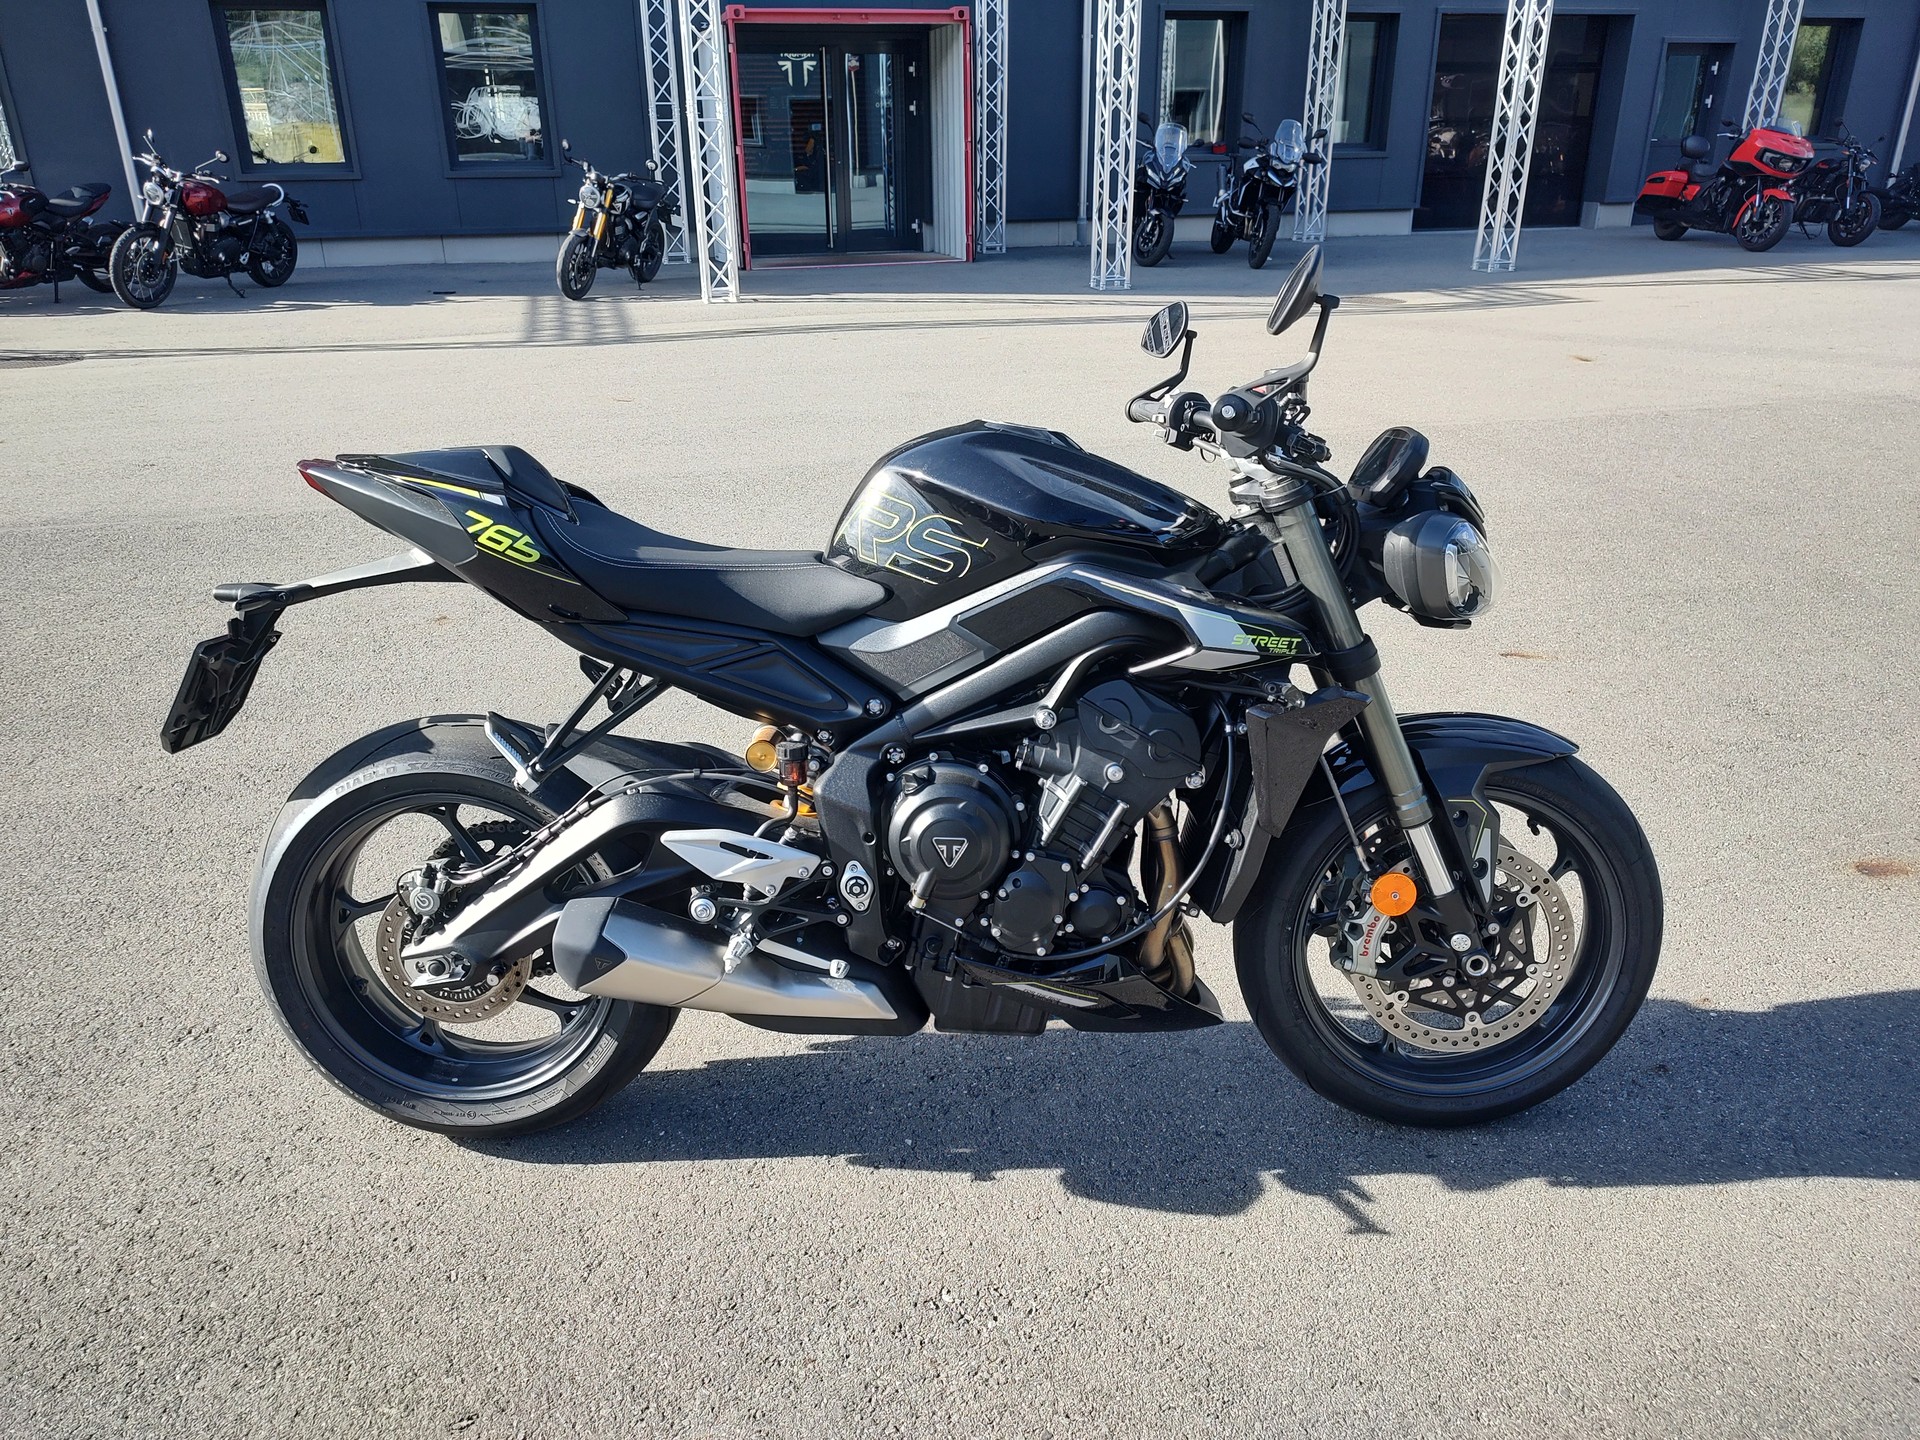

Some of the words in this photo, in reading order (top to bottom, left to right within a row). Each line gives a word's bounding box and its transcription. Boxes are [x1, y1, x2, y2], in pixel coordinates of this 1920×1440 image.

[464, 510, 541, 563] 765
[833, 488, 989, 585] RS
[1231, 634, 1302, 649] STREET
[335, 765, 397, 795] DIABLO
[1359, 915, 1381, 957] brembo
